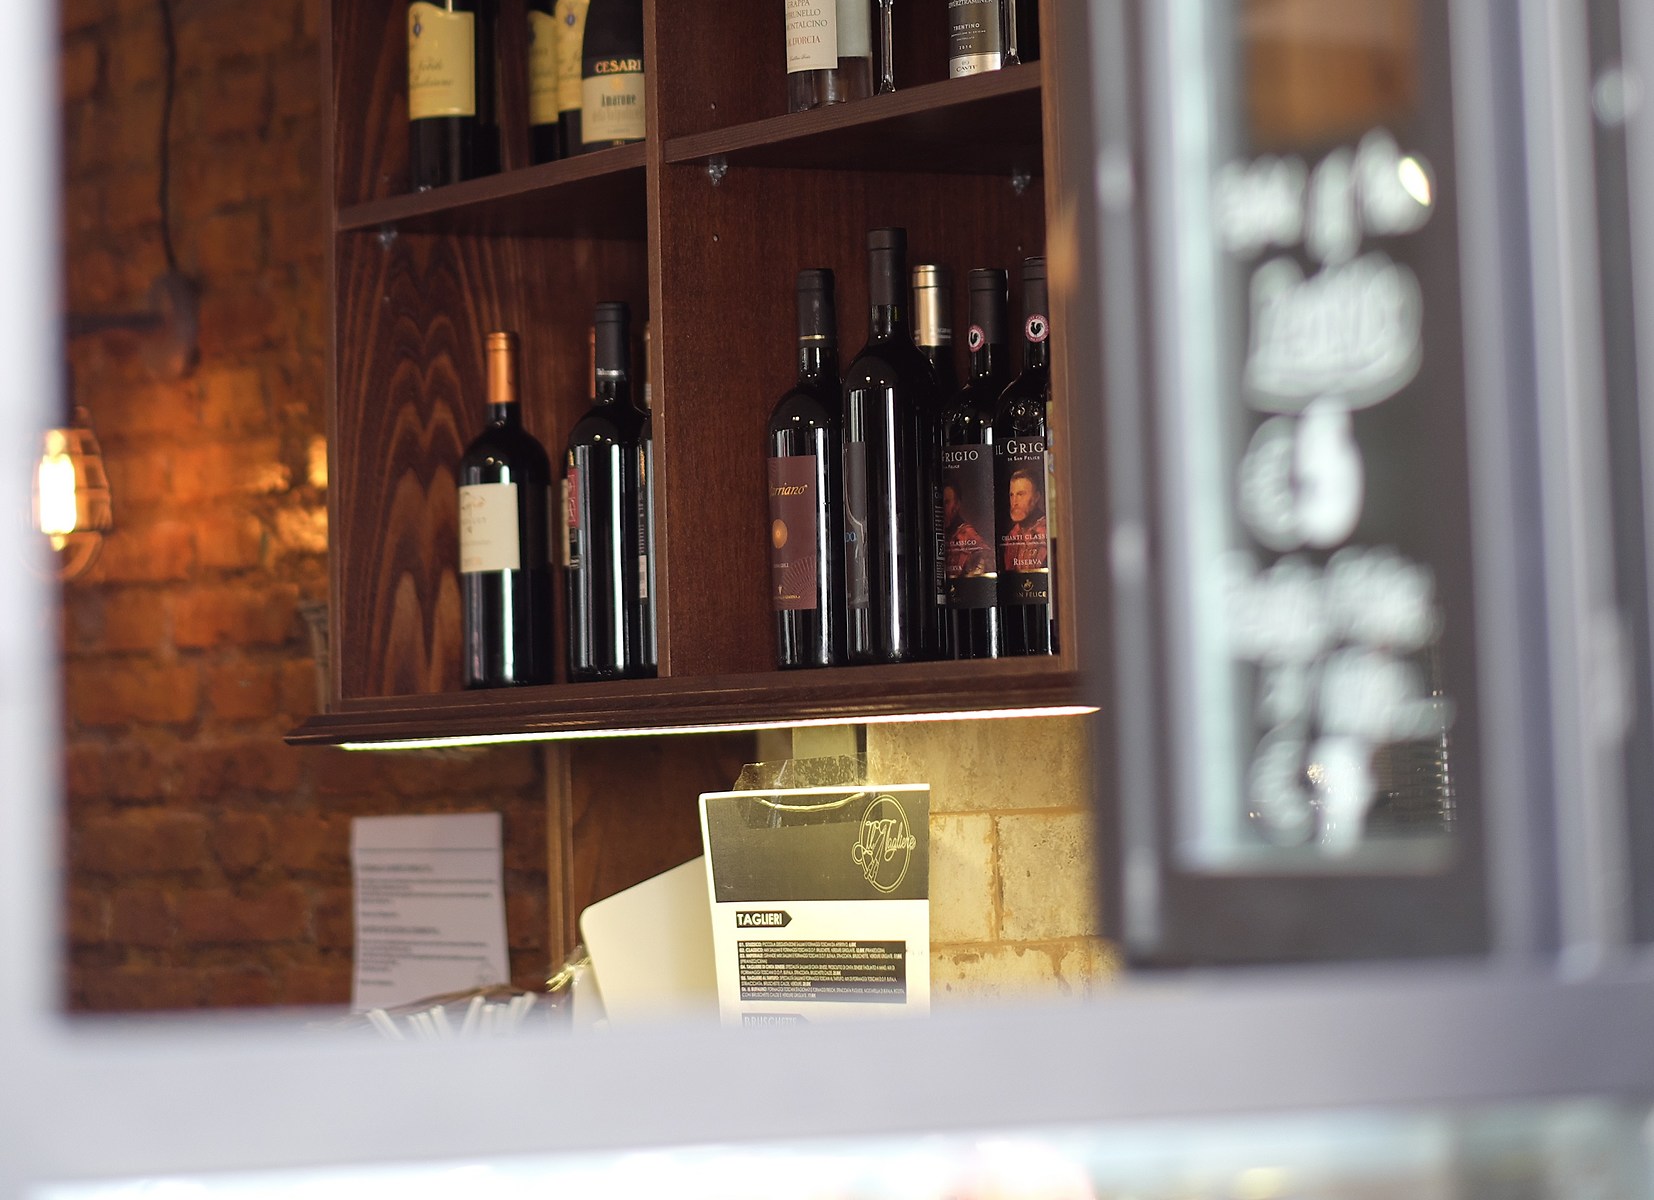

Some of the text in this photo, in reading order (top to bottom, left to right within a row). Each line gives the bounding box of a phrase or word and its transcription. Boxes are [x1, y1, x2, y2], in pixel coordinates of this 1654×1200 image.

[953, 21, 981, 31] TRENTINO
[595, 59, 642, 74] CESARI
[955, 64, 977, 73] CAVIT
[601, 93, 637, 107] Amarone
[995, 445, 1004, 455] IL
[1013, 557, 1042, 566] RISERVA
[737, 912, 783, 926] TAGLIERI
